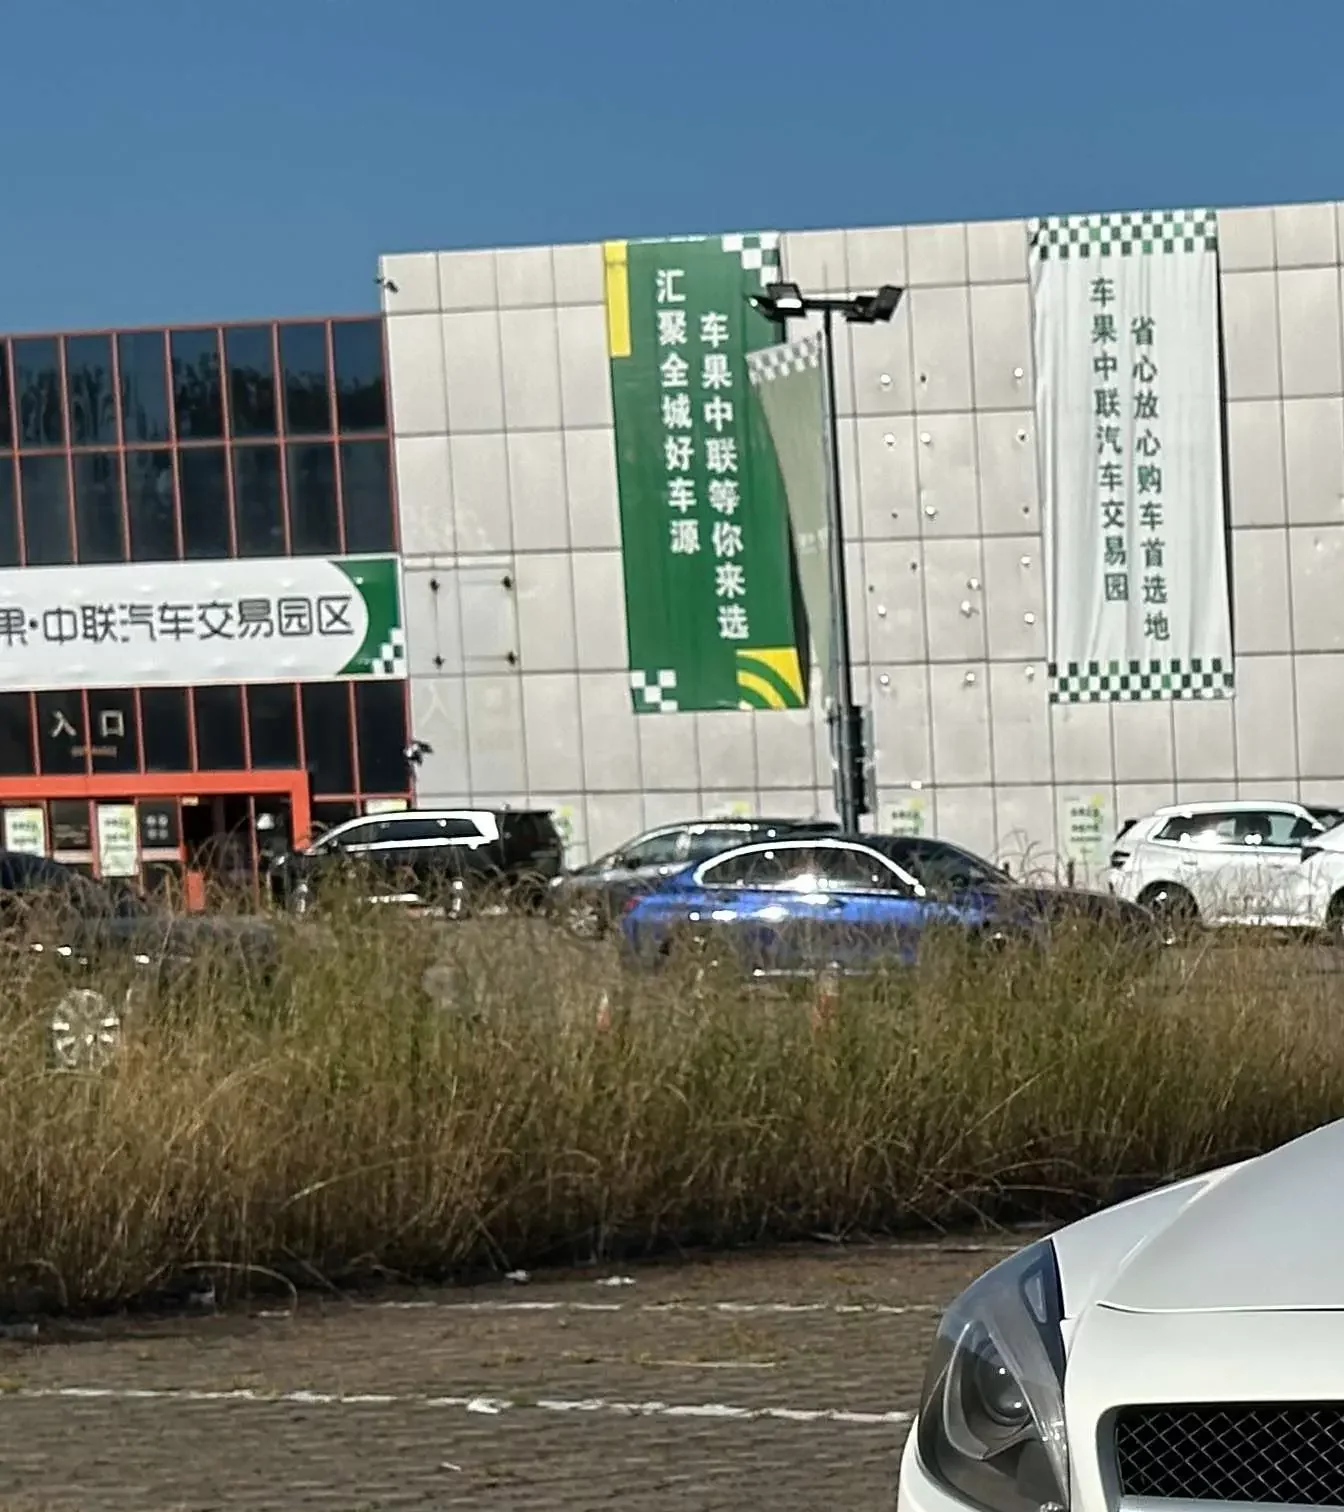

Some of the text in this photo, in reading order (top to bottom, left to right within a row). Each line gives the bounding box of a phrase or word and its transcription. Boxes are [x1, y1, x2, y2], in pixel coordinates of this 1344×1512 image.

[655, 268, 701, 555] 汇聚全城好车源
[699, 311, 750, 640] 车果中联等你来选
[1089, 276, 1129, 602] 车果中联汽车交易园
[1130, 315, 1171, 642] 省心放心购车首选地
[50, 708, 126, 739] 入口
